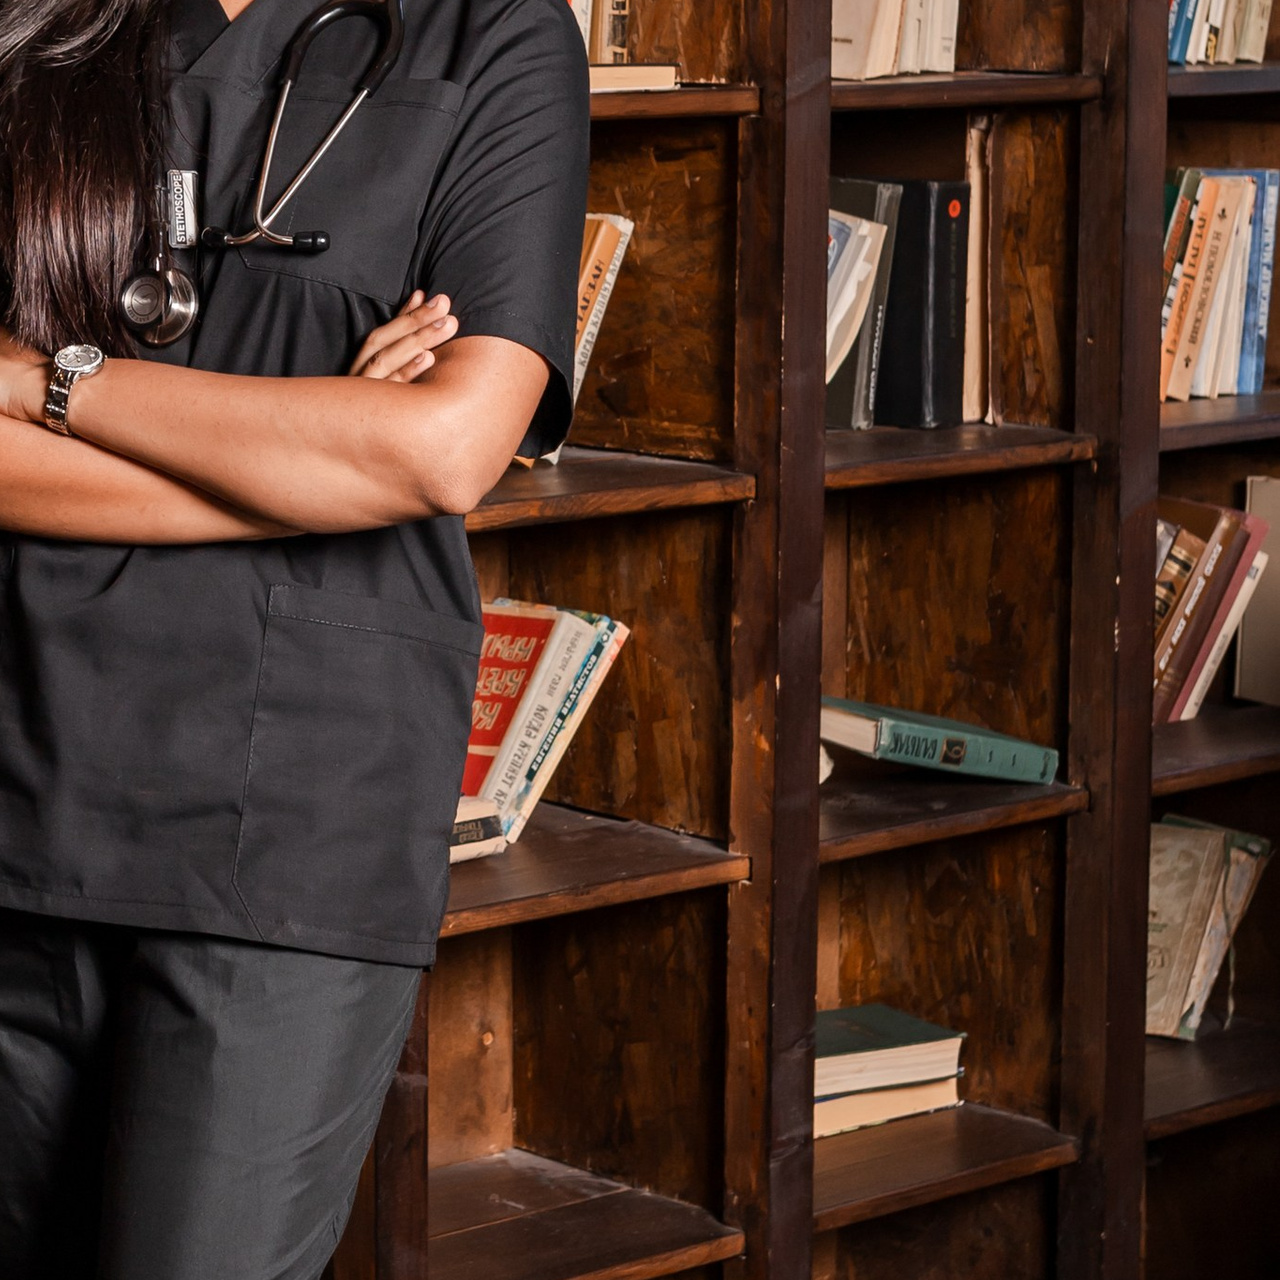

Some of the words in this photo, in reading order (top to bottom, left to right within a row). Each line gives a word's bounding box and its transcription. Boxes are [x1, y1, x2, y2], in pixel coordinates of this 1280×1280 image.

[173, 174, 186, 243] STETHOSCOPE
[531, 717, 563, 772] ЕВГЕНИЙ
[561, 654, 597, 716] ВЕЛТИСТОВ
[887, 730, 937, 759] БАЛЬЗАК
